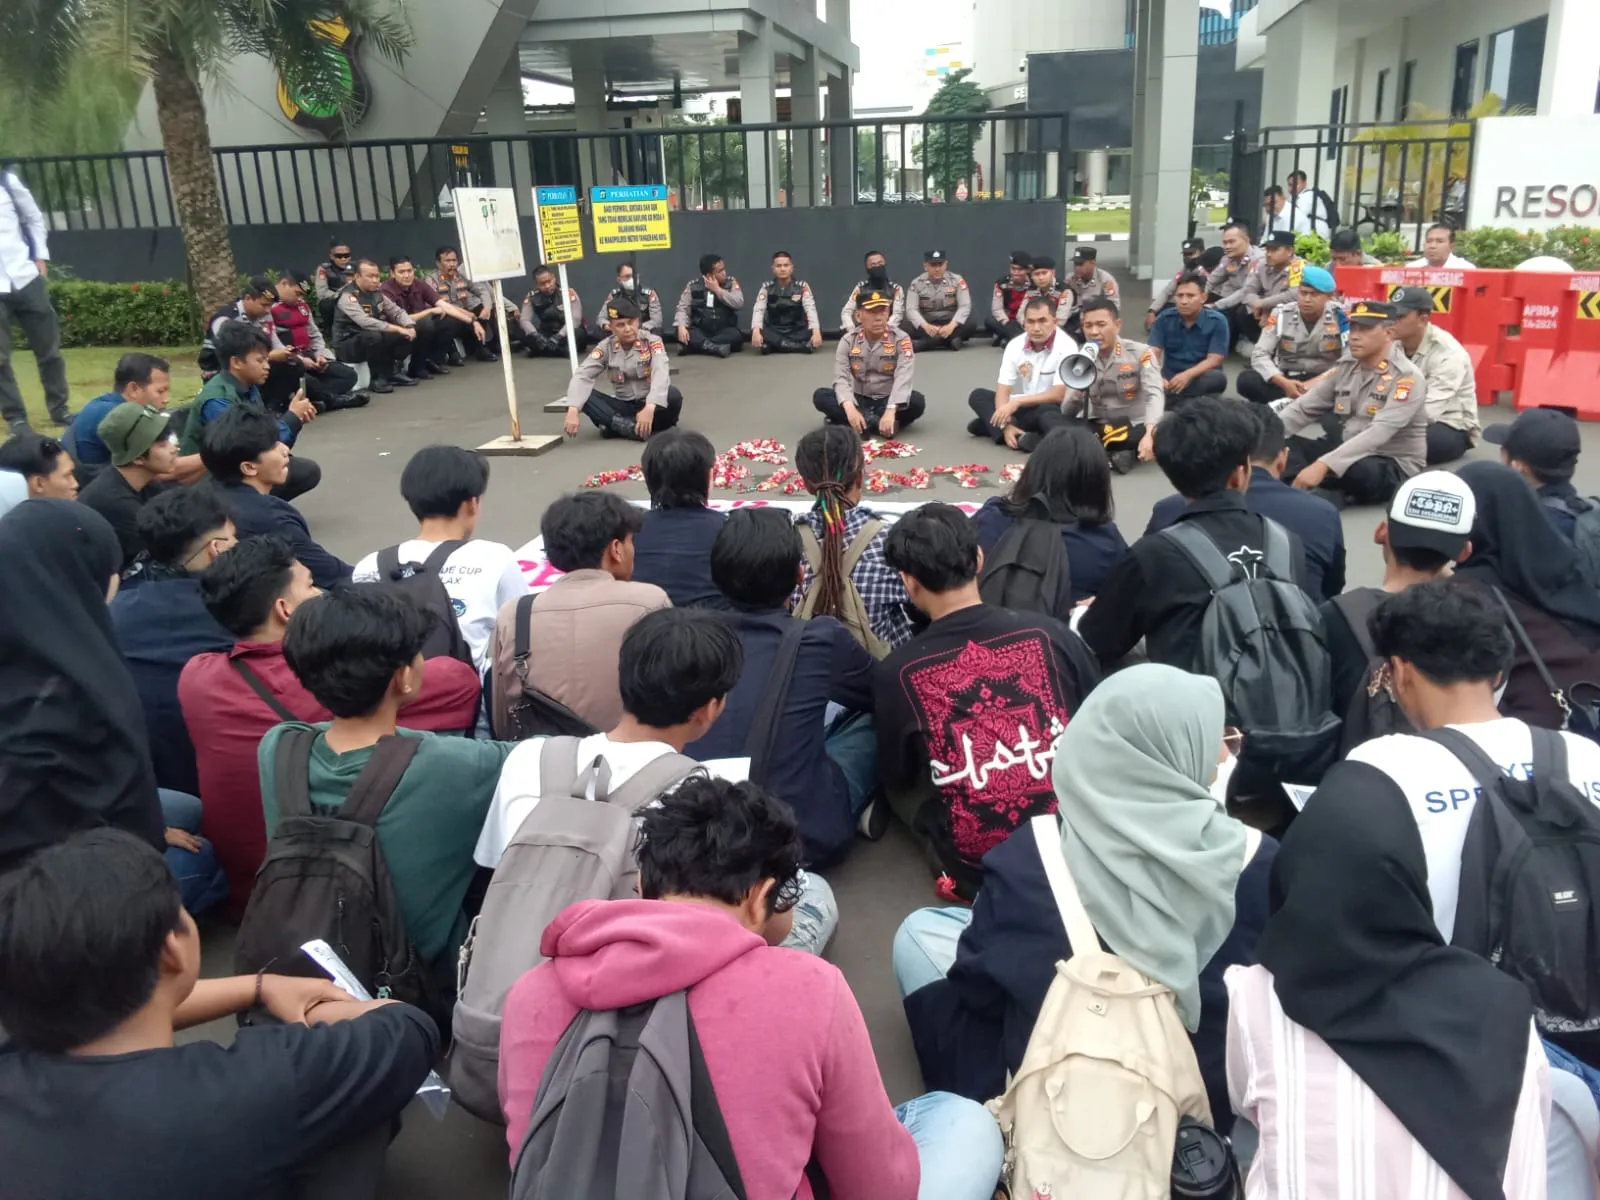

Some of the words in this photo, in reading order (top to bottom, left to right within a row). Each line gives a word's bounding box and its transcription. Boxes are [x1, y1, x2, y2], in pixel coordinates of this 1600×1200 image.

[610, 190, 649, 198] PERHATIAN
[1494, 183, 1600, 219] RESO
[459, 566, 482, 575] CUP
